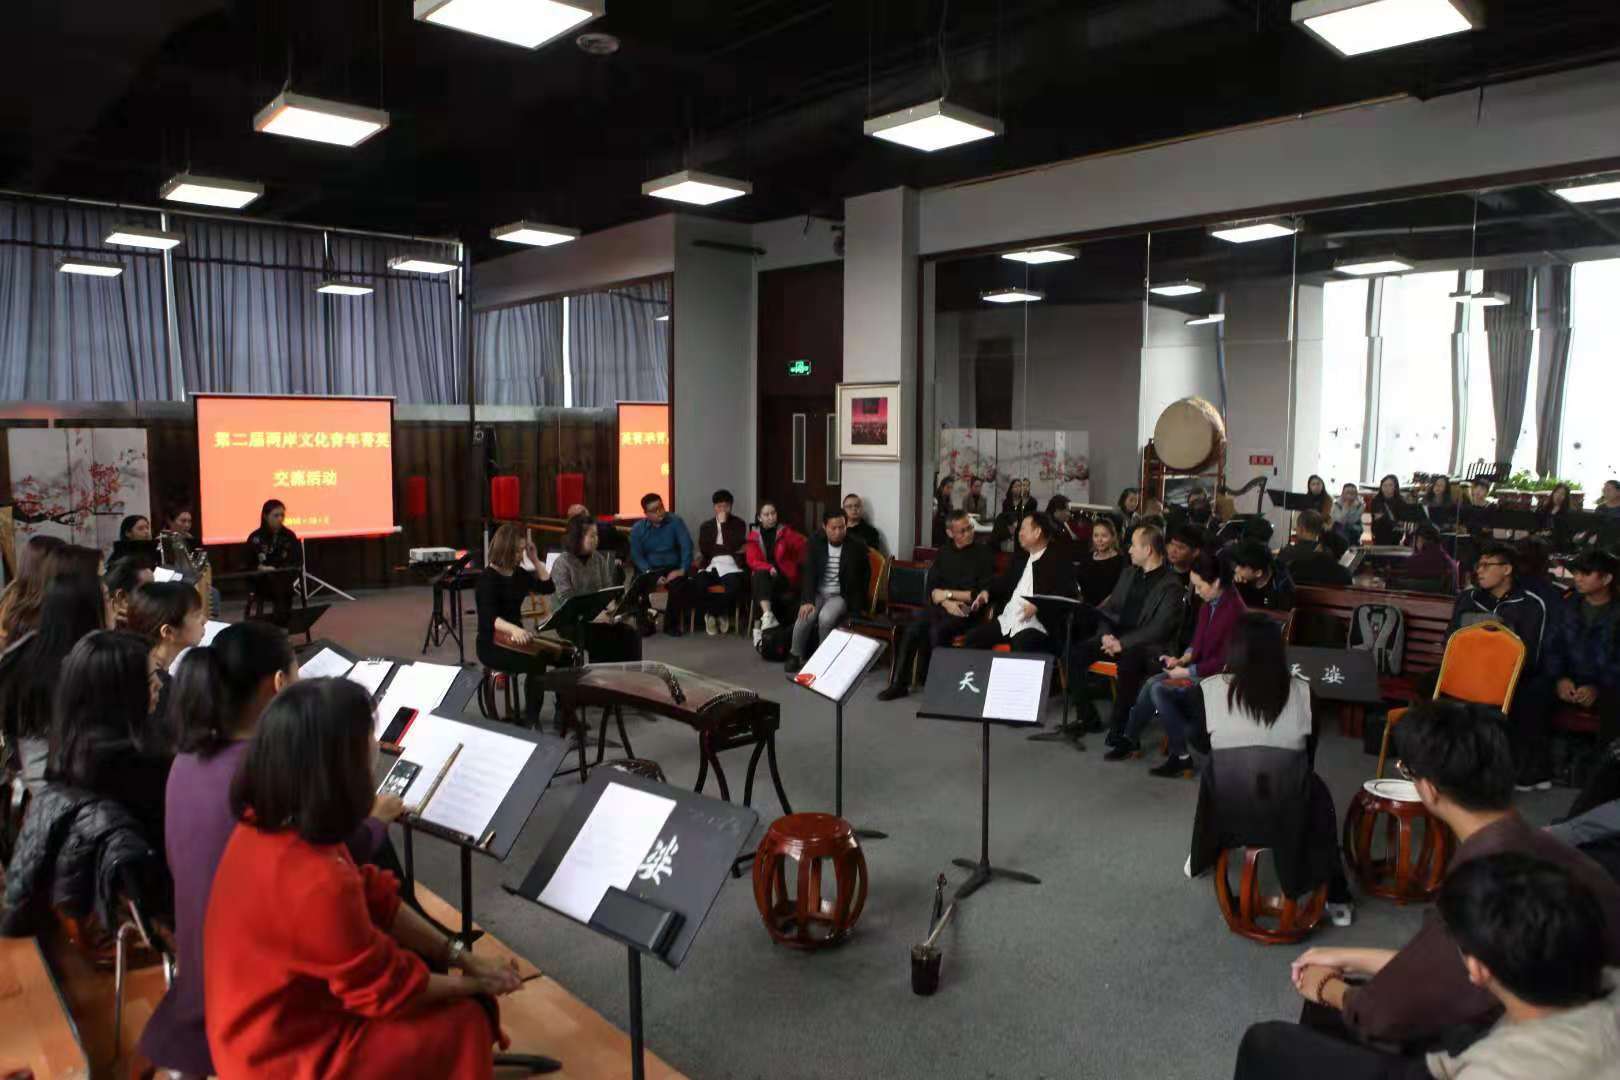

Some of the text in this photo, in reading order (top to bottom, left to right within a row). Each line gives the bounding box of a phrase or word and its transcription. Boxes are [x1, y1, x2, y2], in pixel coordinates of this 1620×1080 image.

[272, 470, 337, 487] 交流活动
[959, 671, 980, 693] 天
